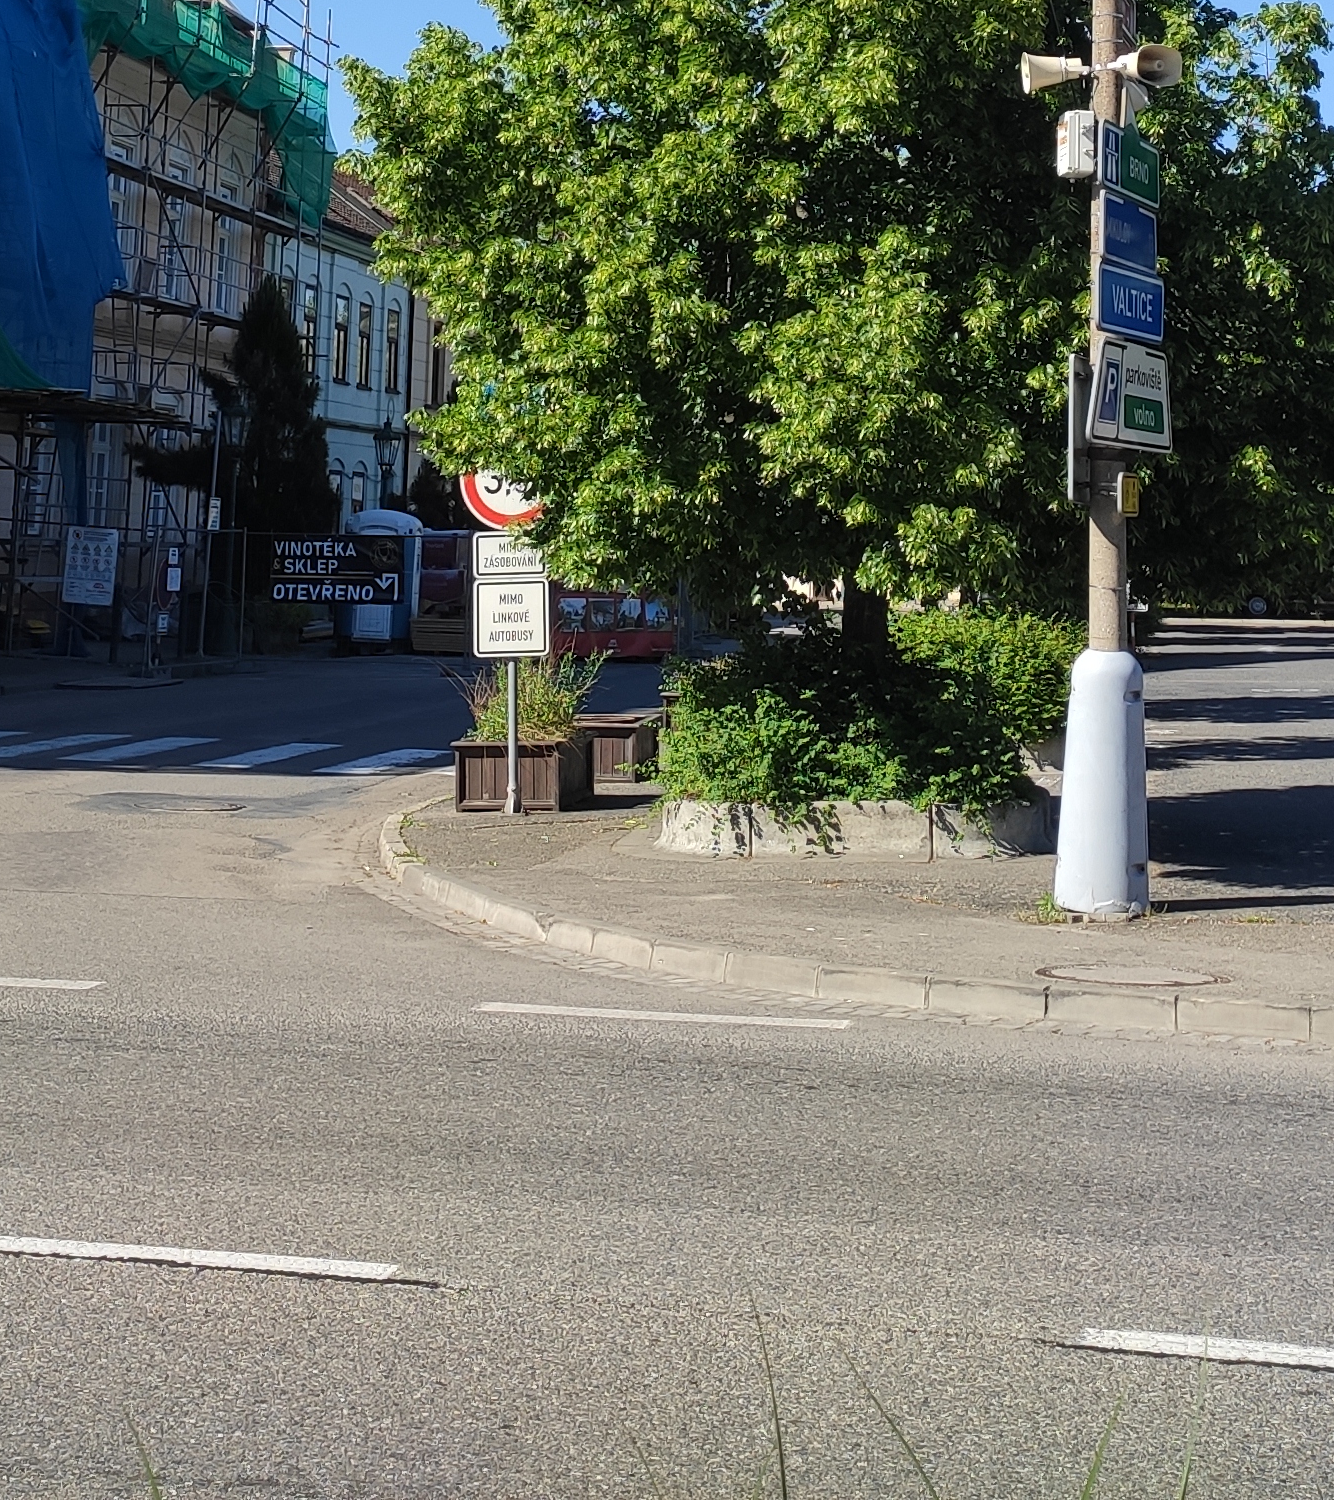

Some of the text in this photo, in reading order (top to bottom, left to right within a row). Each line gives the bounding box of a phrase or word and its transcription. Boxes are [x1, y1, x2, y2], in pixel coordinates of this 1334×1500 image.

[1129, 155, 1149, 185] BRNO
[1112, 284, 1153, 323] VALTICE
[1104, 367, 1117, 403] P
[1125, 364, 1162, 392] parkoviště
[1133, 404, 1155, 427] volno
[273, 537, 357, 557] VINOTÉKA
[273, 558, 339, 574] & SKLEP
[272, 579, 374, 601] OTEVŘENO
[499, 593, 523, 605] MIMO
[493, 609, 530, 623] LINKOVÉ
[489, 630, 534, 642] AUTOBUSY
